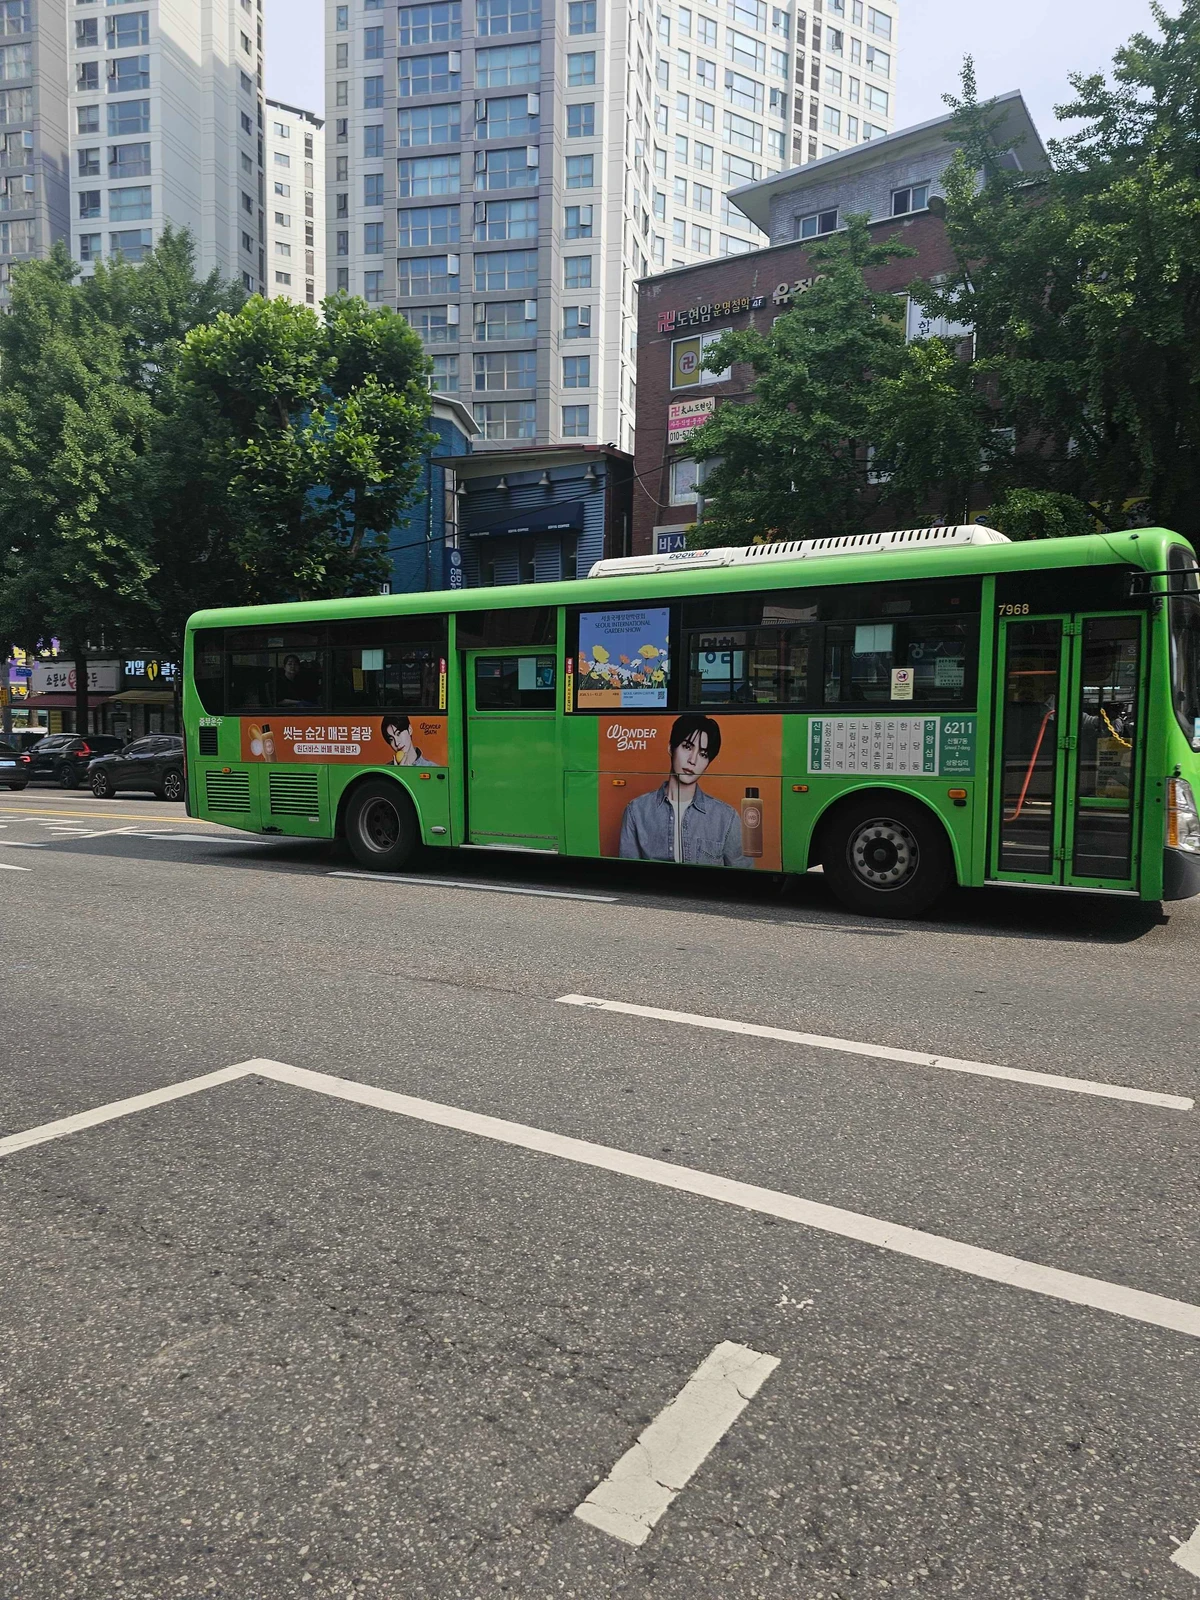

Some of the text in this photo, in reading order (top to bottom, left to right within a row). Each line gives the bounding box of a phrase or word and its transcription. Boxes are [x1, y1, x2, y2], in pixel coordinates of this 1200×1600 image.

[677, 304, 713, 327] 도현암
[713, 297, 750, 317] 운명철학
[998, 603, 1030, 616] 7968
[612, 620, 651, 628] INTERNATIONAL
[125, 660, 145, 676] 리얼
[283, 726, 372, 742] 씻는 순간 매끈 결광
[606, 724, 657, 739] WONDER
[944, 721, 973, 734] 6211
[297, 744, 319, 753] 원더바스
[617, 736, 647, 751] BATH
[813, 722, 821, 770] 신월7동
[836, 722, 844, 769] 문래역
[860, 722, 869, 769] 노량진역
[899, 722, 907, 770] 한남동
[912, 721, 921, 770] 신당동
[924, 721, 934, 771] 상왕십리
